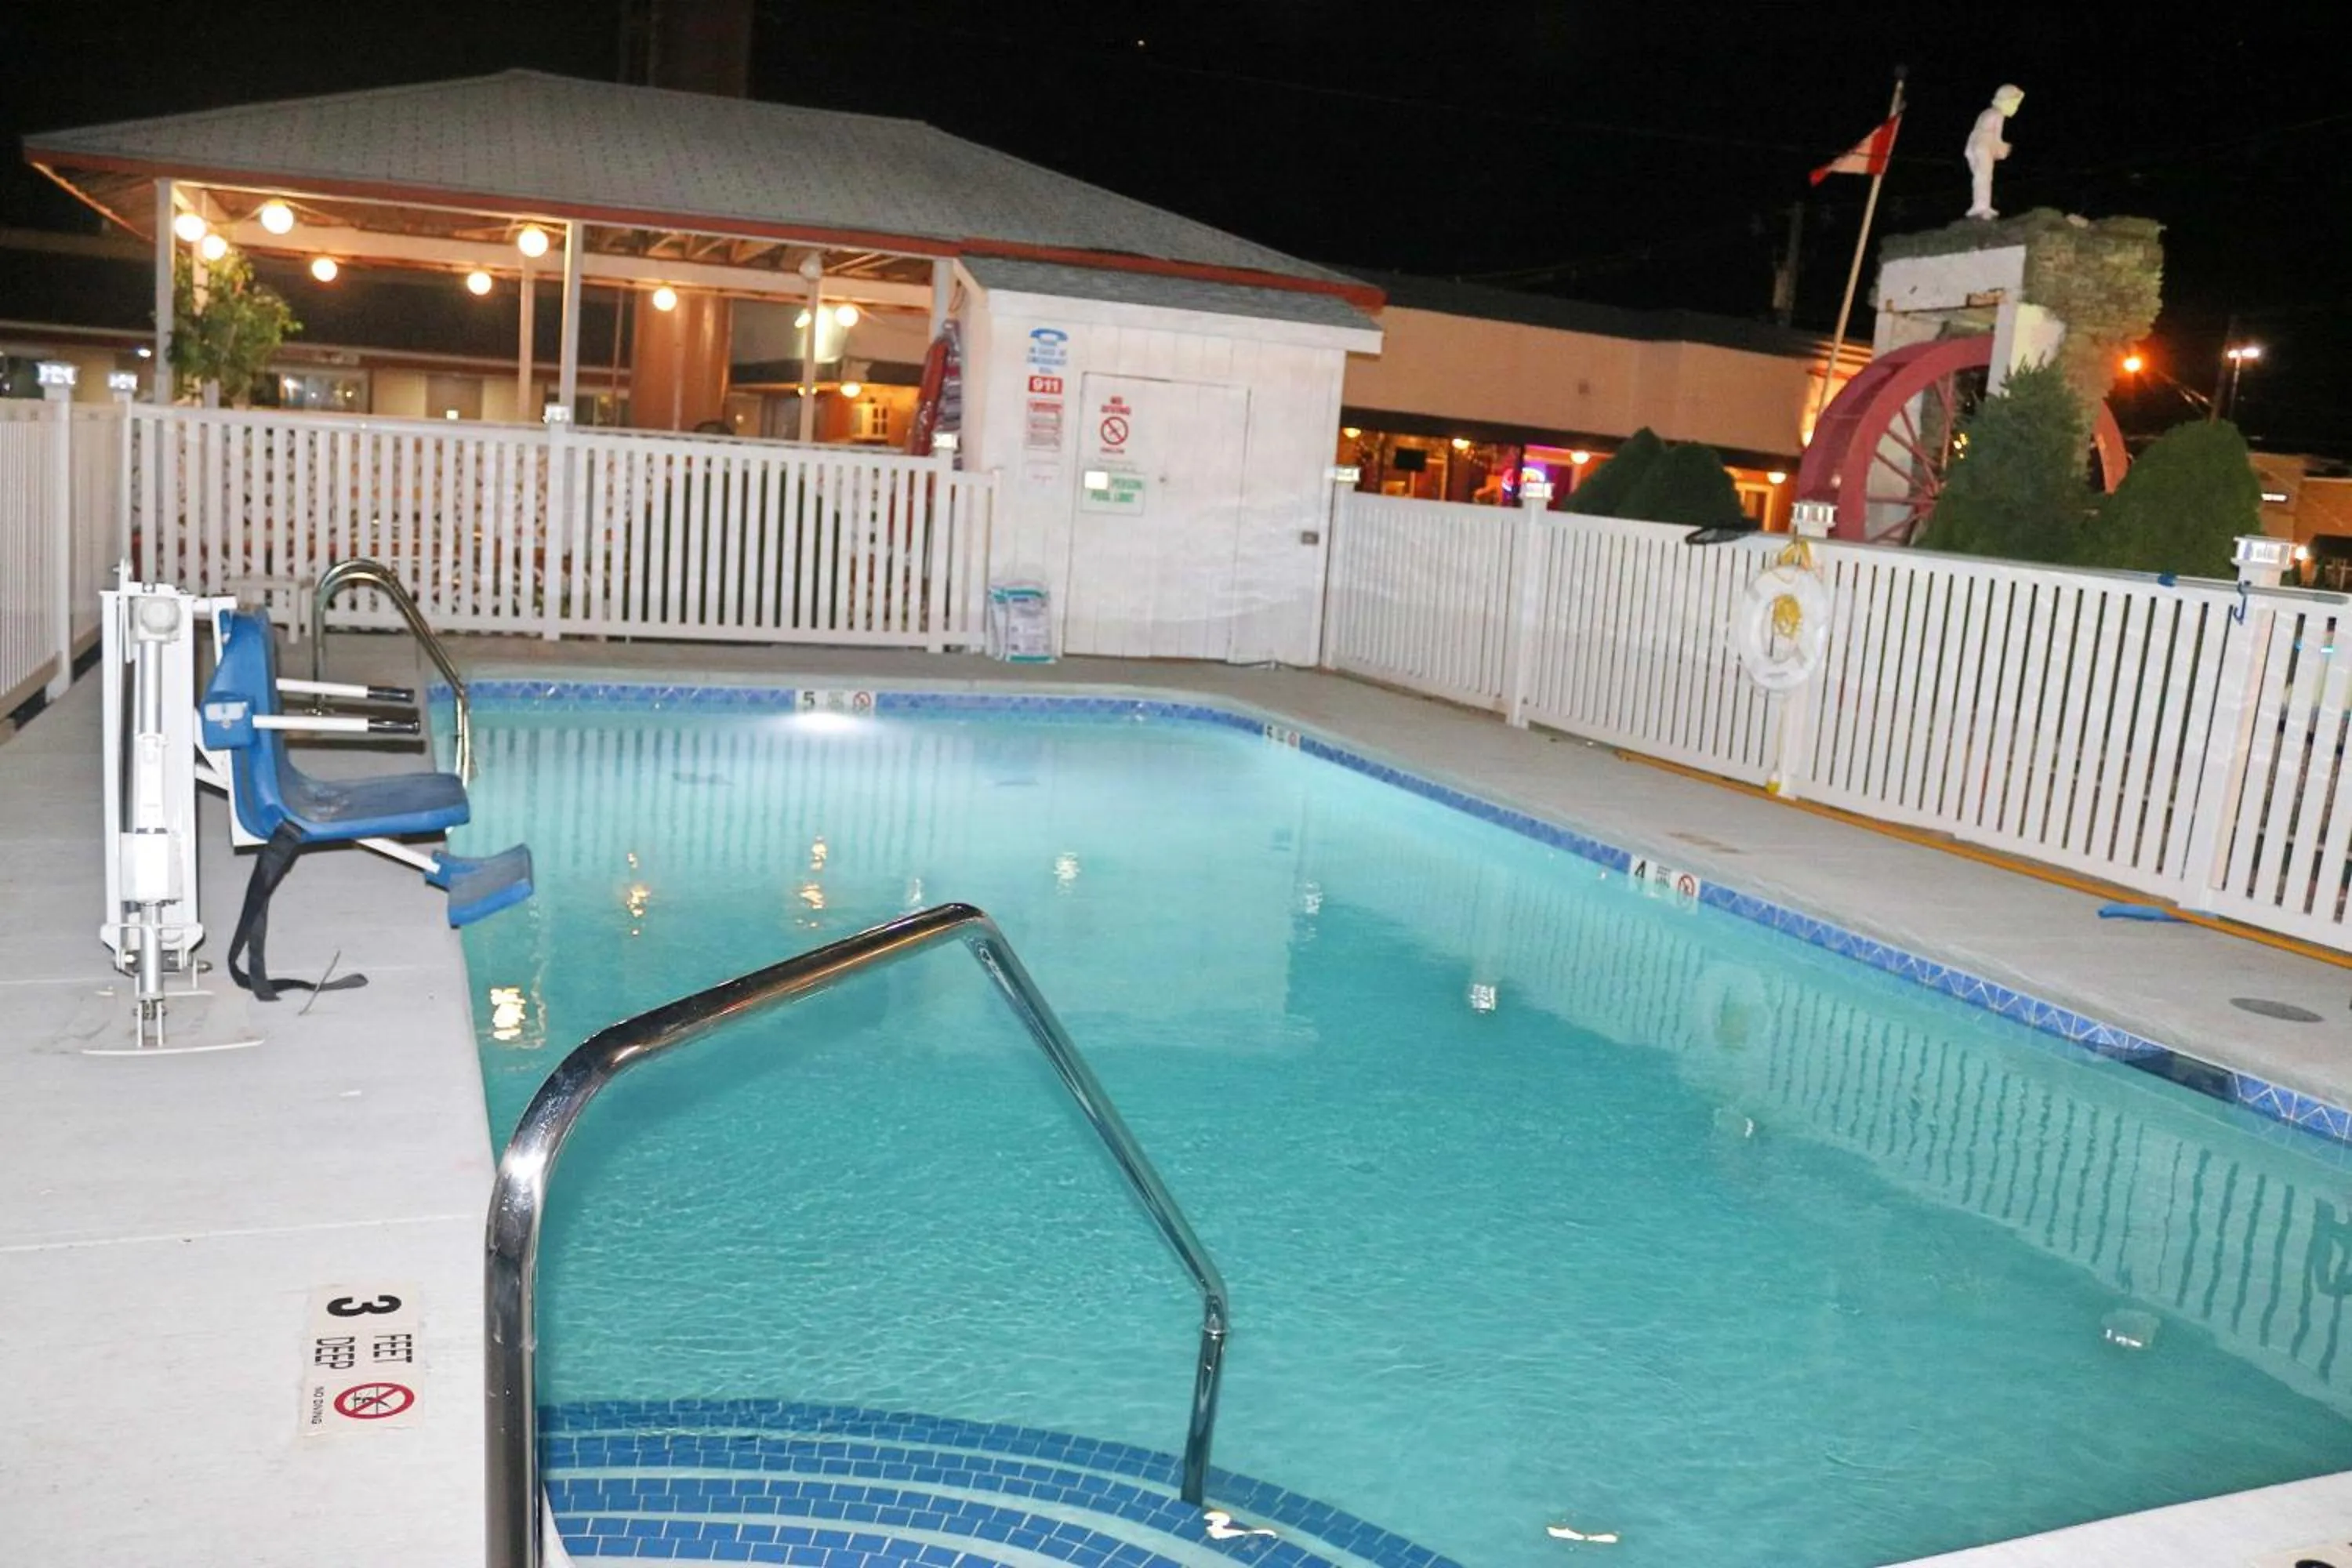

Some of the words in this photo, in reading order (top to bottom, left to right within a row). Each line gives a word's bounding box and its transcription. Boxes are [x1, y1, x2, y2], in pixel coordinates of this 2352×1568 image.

[1033, 378, 1059, 392] 911
[803, 691, 815, 706] 5
[1634, 860, 1646, 879] 4
[326, 1294, 402, 1317] 3
[314, 1336, 354, 1369] DEEP
[373, 1334, 412, 1363] FEET
